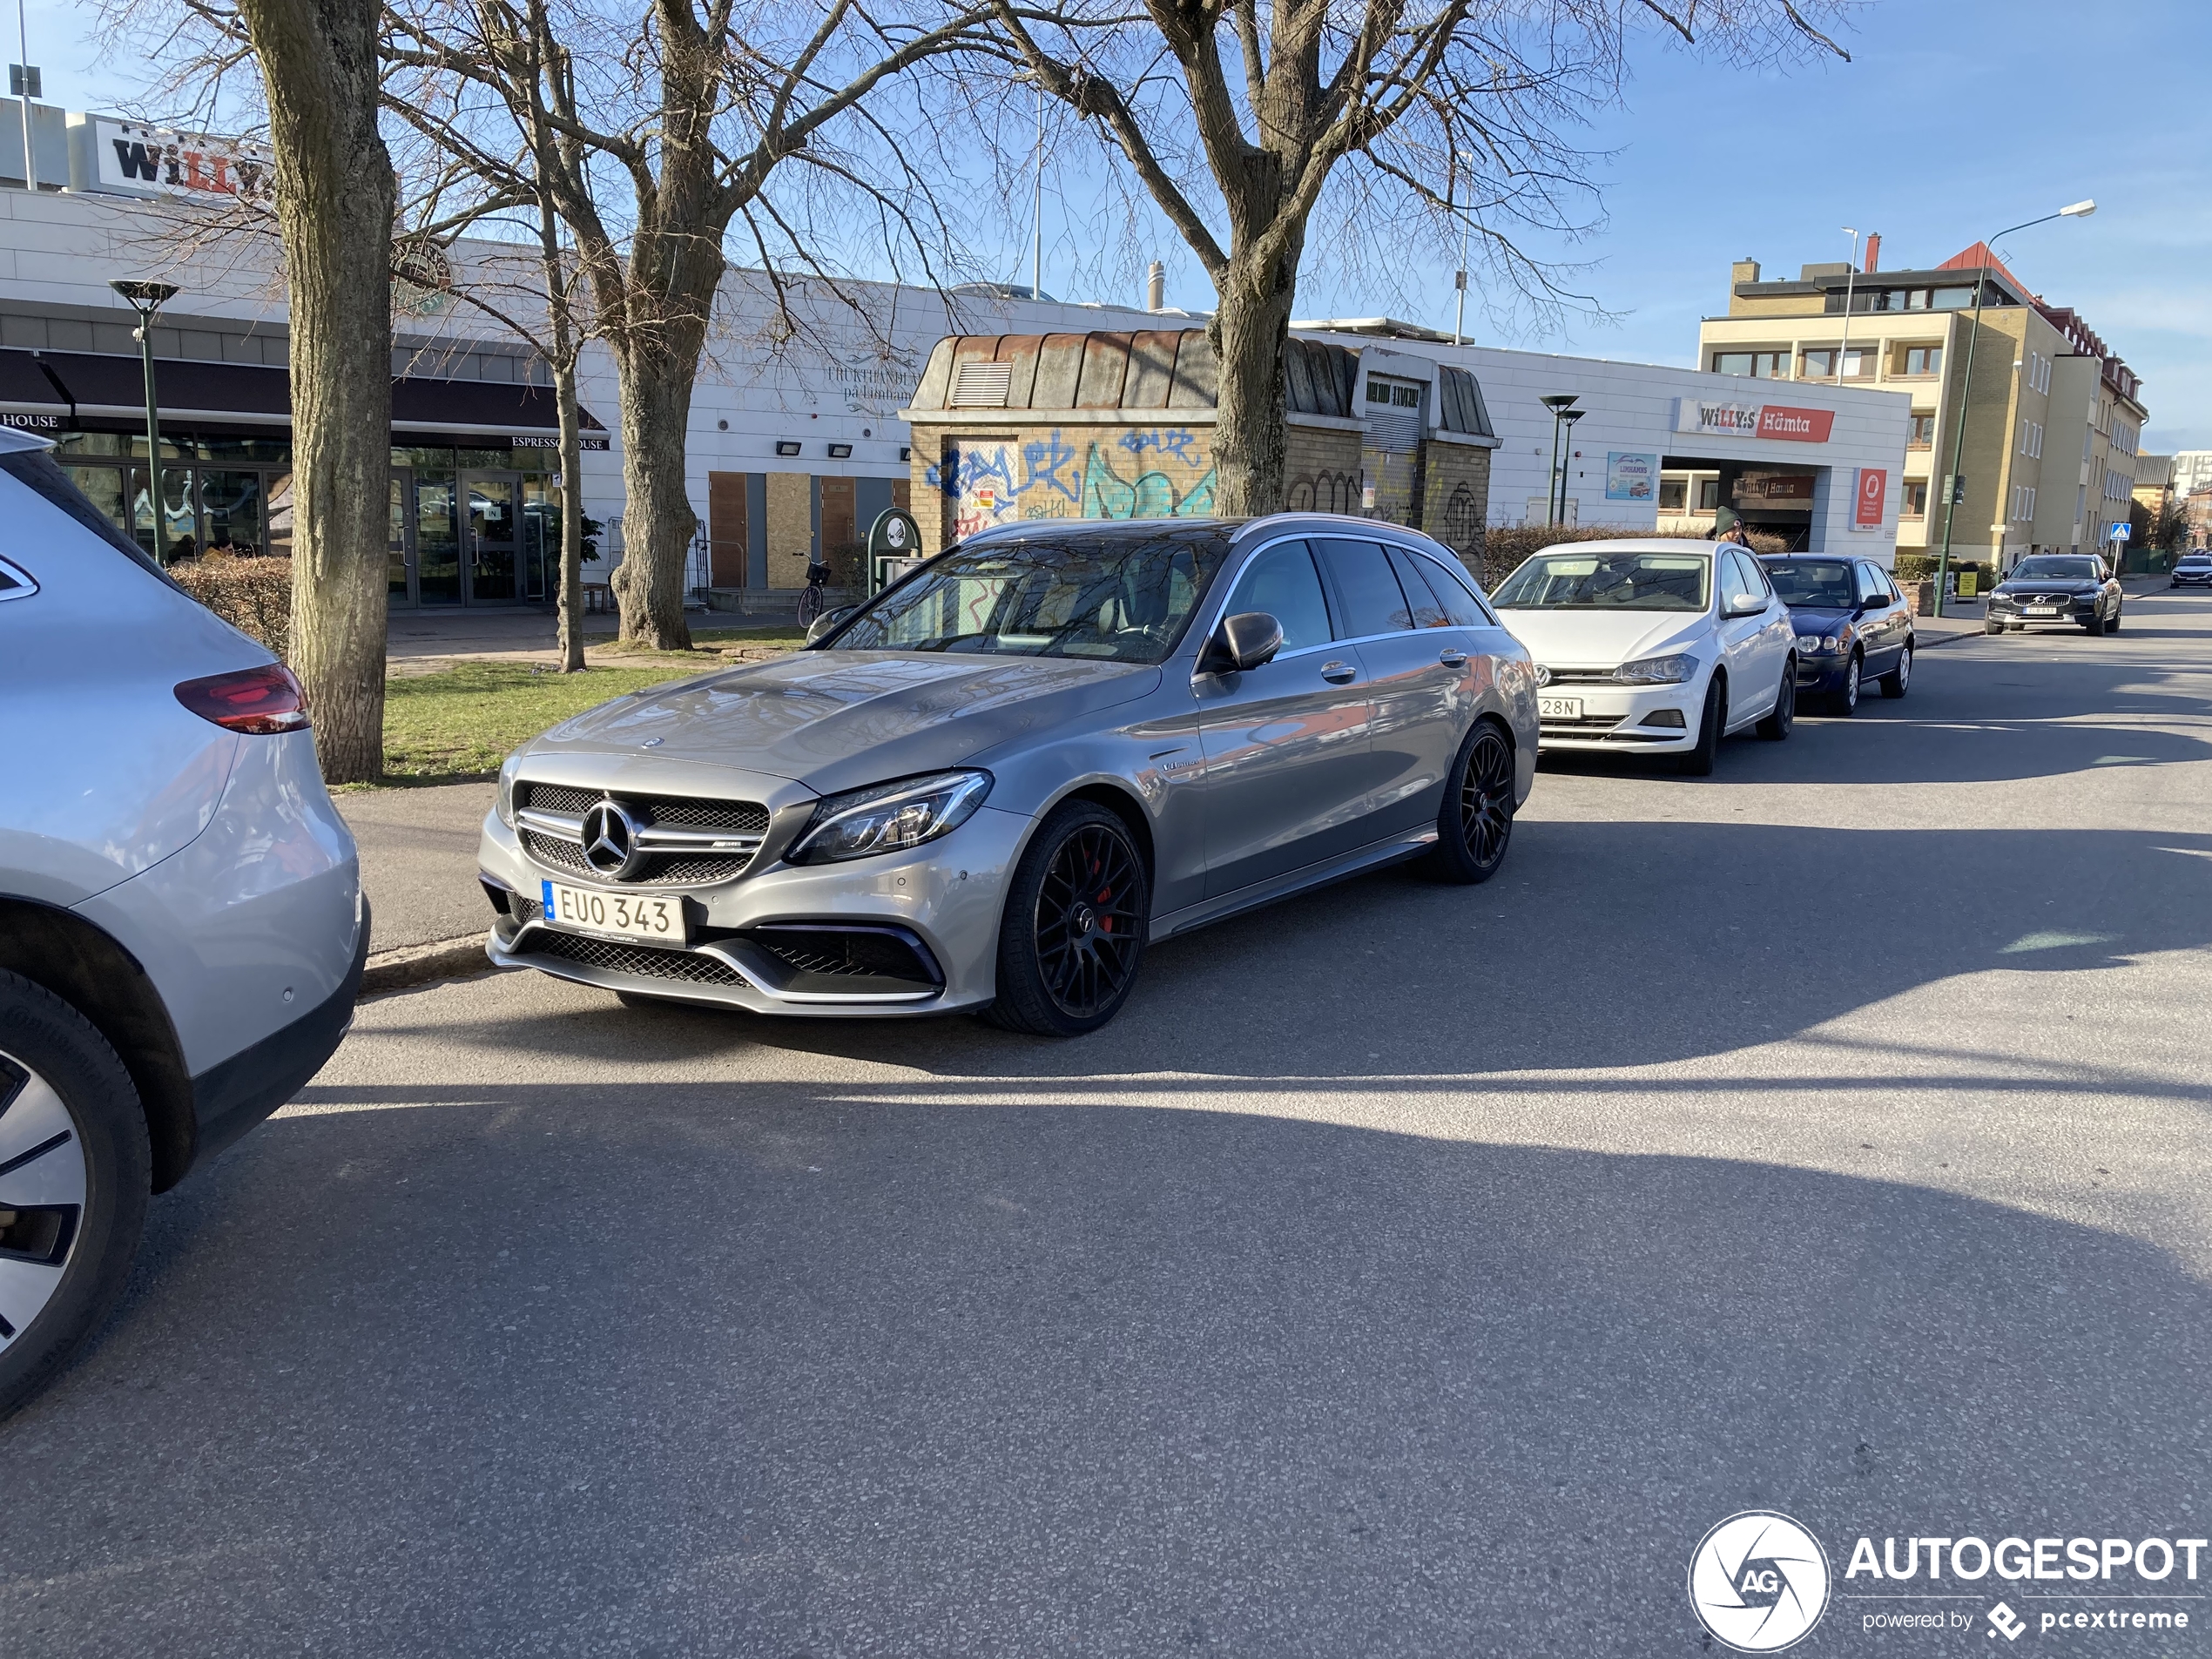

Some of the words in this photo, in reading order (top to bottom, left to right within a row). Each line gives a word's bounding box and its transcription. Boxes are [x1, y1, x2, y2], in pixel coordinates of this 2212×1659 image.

[844, 385, 858, 401] på
[2, 414, 58, 428] HOUSE
[1763, 412, 1811, 433] Hämta
[1542, 699, 1574, 715] 28N
[548, 905, 552, 914] S
[613, 898, 669, 933] 343
